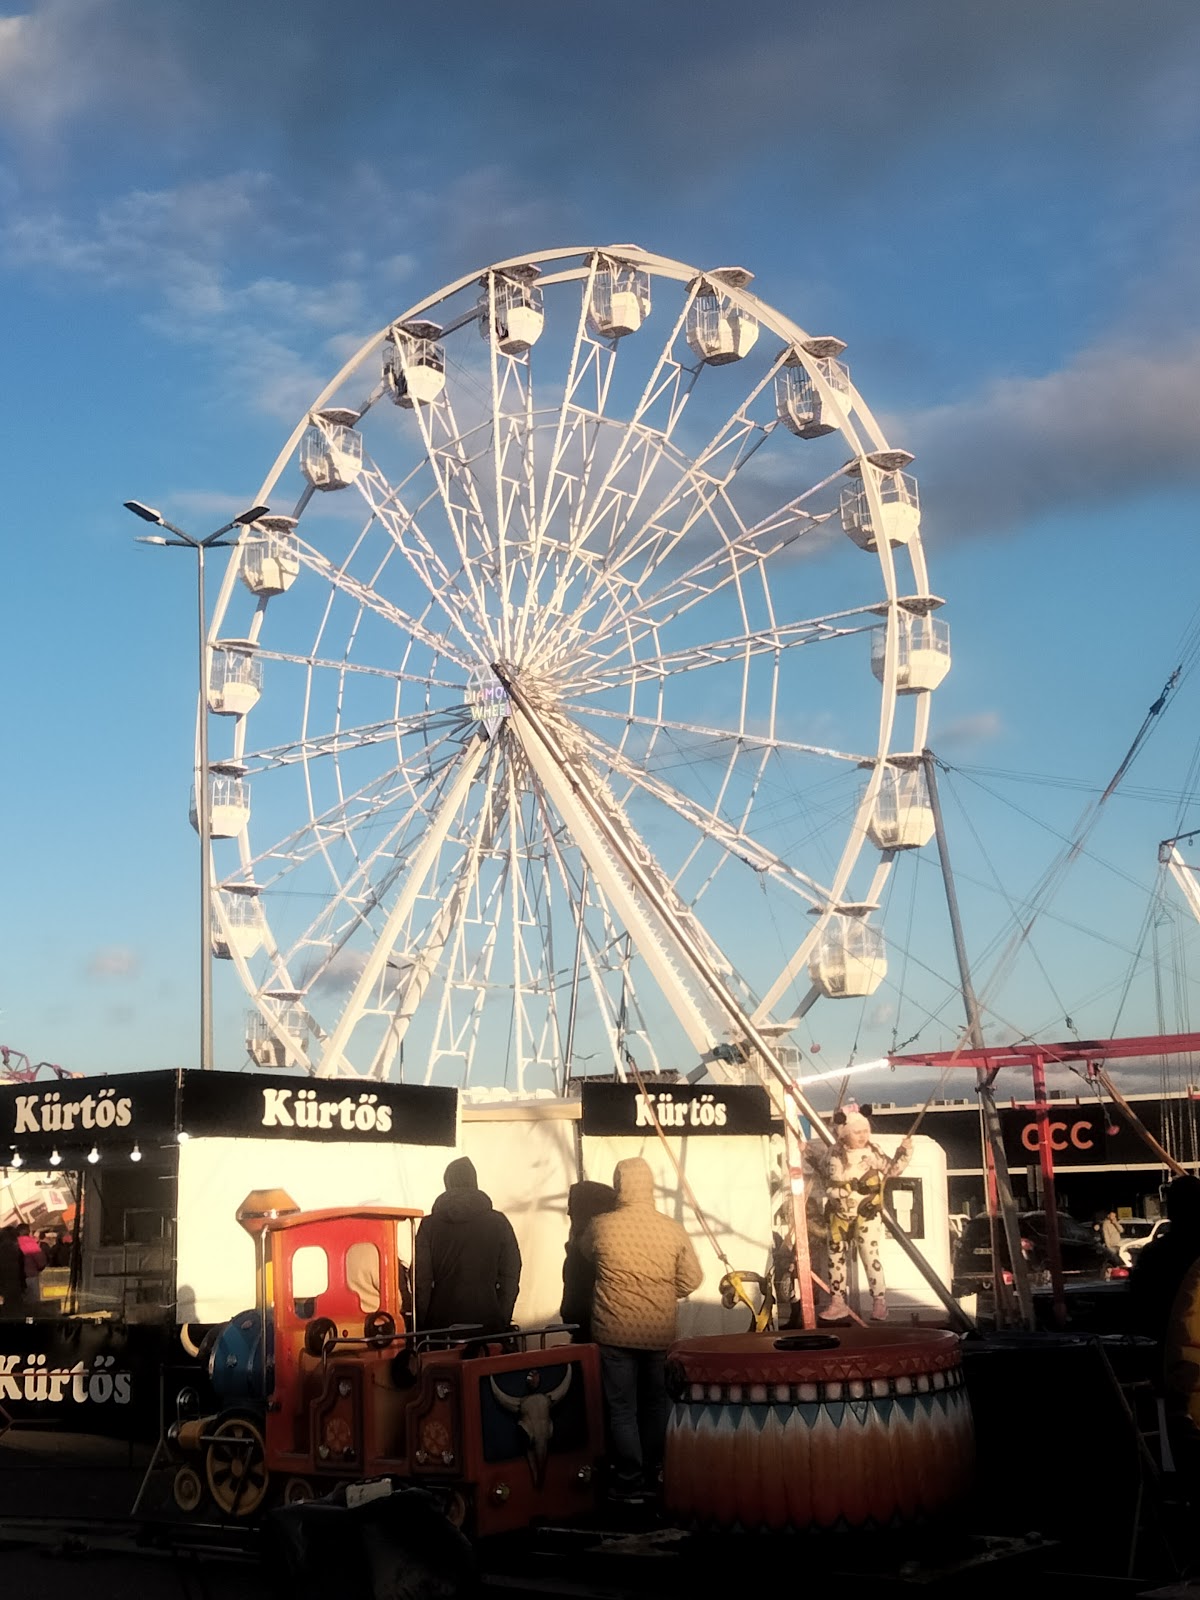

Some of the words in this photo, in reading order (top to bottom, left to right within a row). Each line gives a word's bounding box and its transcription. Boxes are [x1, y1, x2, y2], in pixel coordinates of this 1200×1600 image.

[471, 701, 512, 720] WHEEL
[14, 1088, 132, 1134] Kürtős
[261, 1088, 392, 1132] Kürtős
[635, 1093, 727, 1127] Kürtős
[1022, 1121, 1094, 1151] CCC
[0, 1354, 131, 1404] Kürtős
